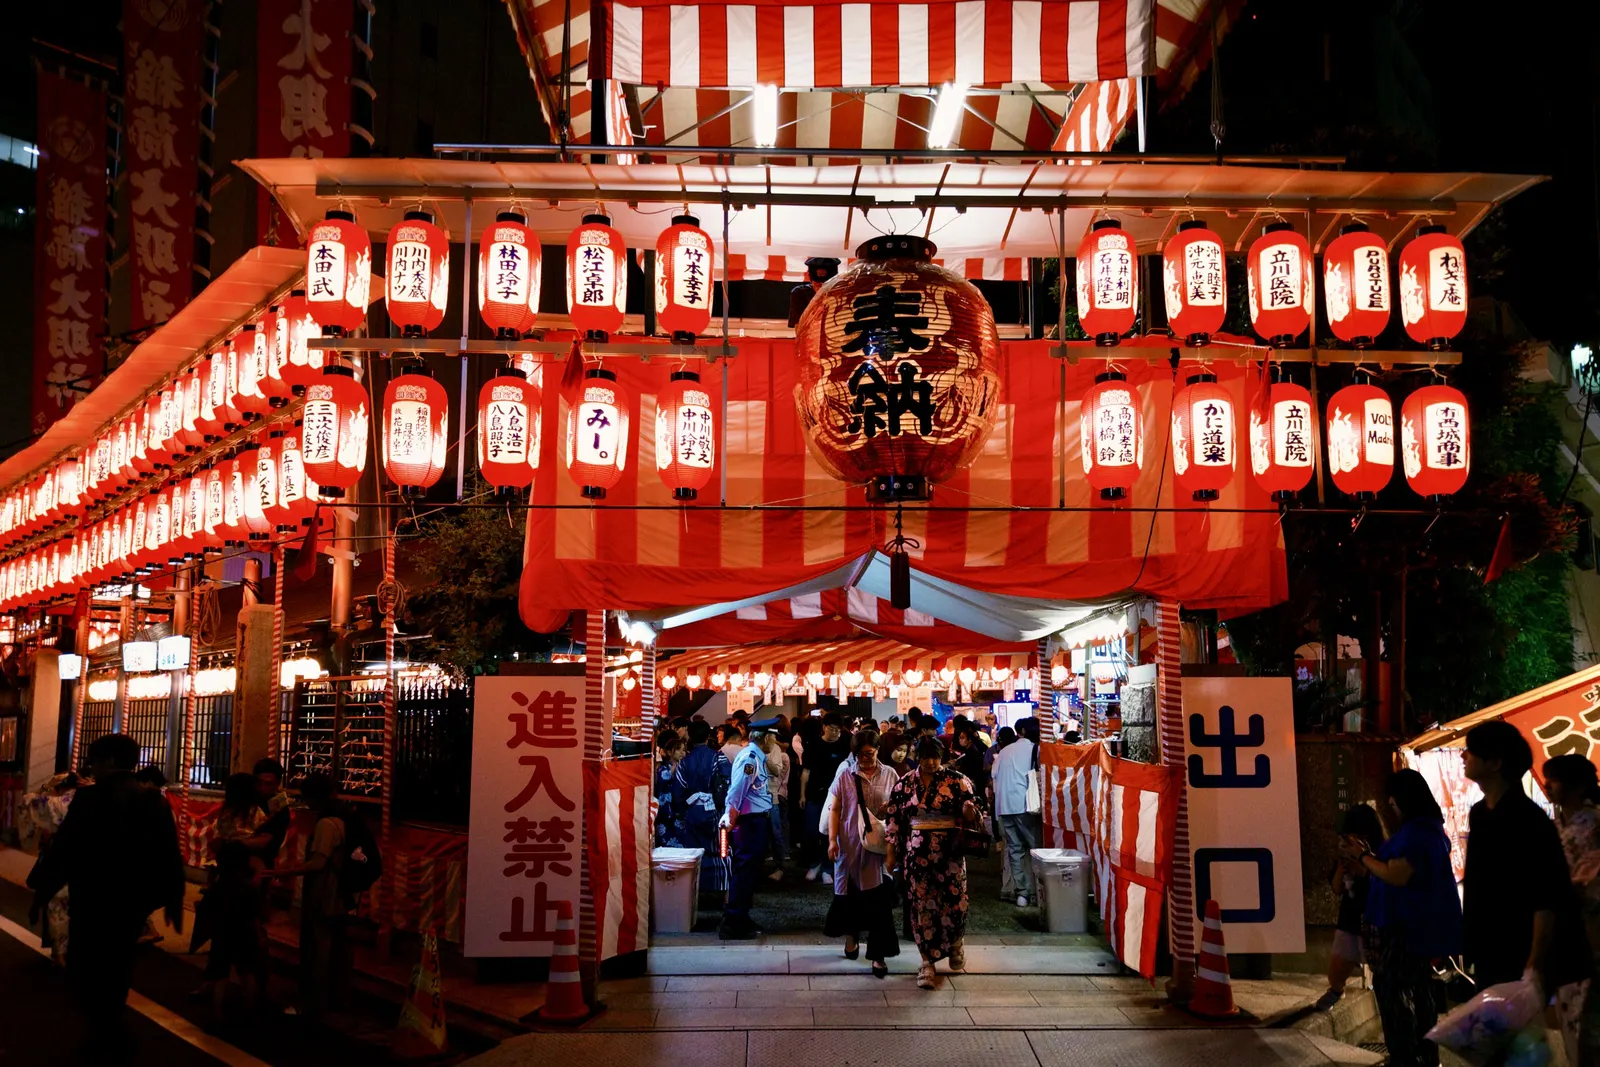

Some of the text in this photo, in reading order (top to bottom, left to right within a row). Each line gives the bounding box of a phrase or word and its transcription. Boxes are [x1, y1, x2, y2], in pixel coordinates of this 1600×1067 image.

[312, 243, 337, 297] 本田武
[393, 246, 408, 295] 川内ナツ
[496, 245, 521, 299] 林田玲子
[582, 246, 605, 304] 松江卓郎
[683, 247, 704, 304] 竹本幸子
[1097, 252, 1114, 305] 石井隆志
[1116, 252, 1129, 305] 石井利明
[1188, 245, 1206, 301] 沖元恵美
[1270, 250, 1295, 307] 立川医院
[841, 286, 937, 438] 奉納
[315, 404, 333, 459] 三次俊彦
[490, 404, 505, 458] 八島照子
[506, 404, 523, 456] 八島浩一
[680, 408, 697, 460] 中川玲子
[1203, 403, 1226, 463] かに道楽
[1285, 406, 1308, 462] 立川医院
[498, 689, 578, 943] 進入禁止
[1187, 705, 1275, 924] 出口
